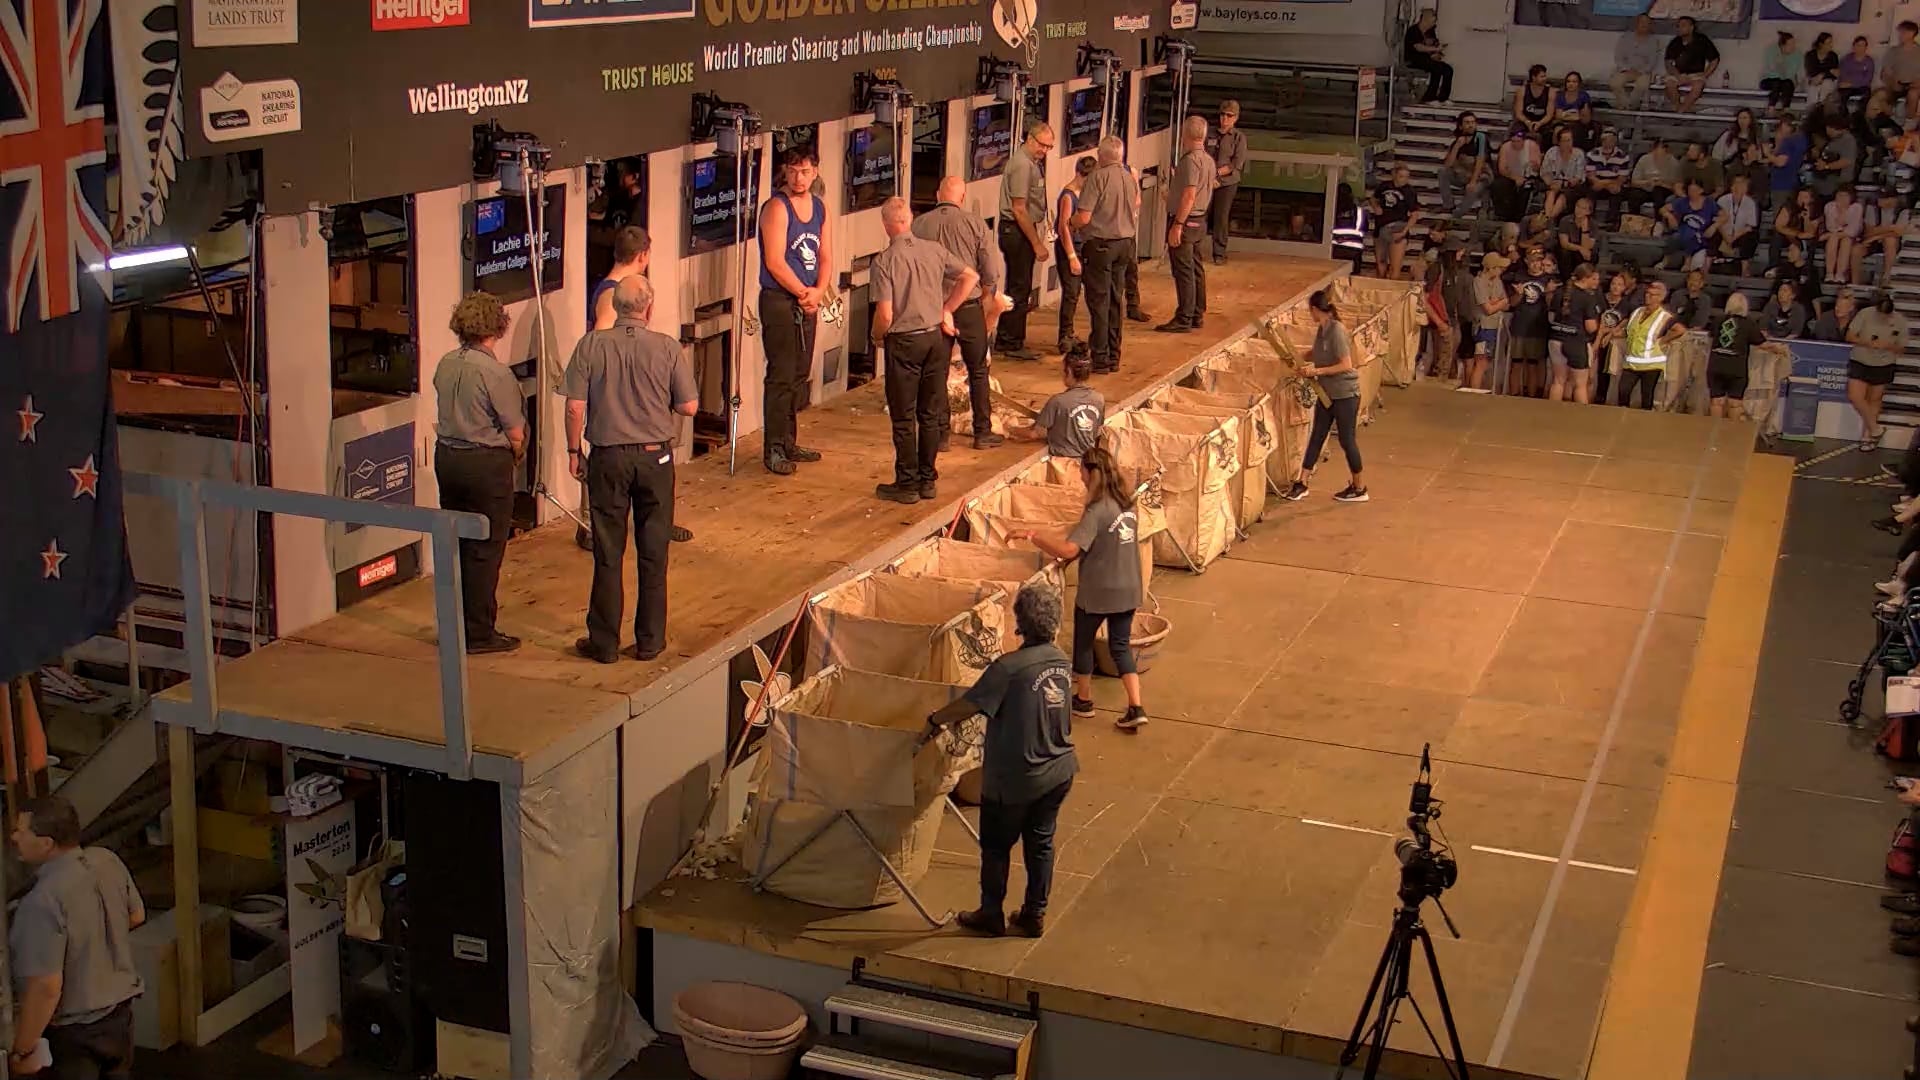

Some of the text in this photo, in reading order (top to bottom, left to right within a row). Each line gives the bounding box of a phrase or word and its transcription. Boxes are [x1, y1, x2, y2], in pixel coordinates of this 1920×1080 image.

[208, 10, 285, 25] LANDS TRUST
[704, 20, 982, 72] World Premier Shearing and Woolhandling Championship
[602, 62, 695, 91] TRUST HOUSE
[261, 89, 295, 101] NATIONAL
[408, 79, 529, 115] WellingtonNZ
[492, 236, 521, 254] Lachie
[293, 820, 351, 857] Masterton
